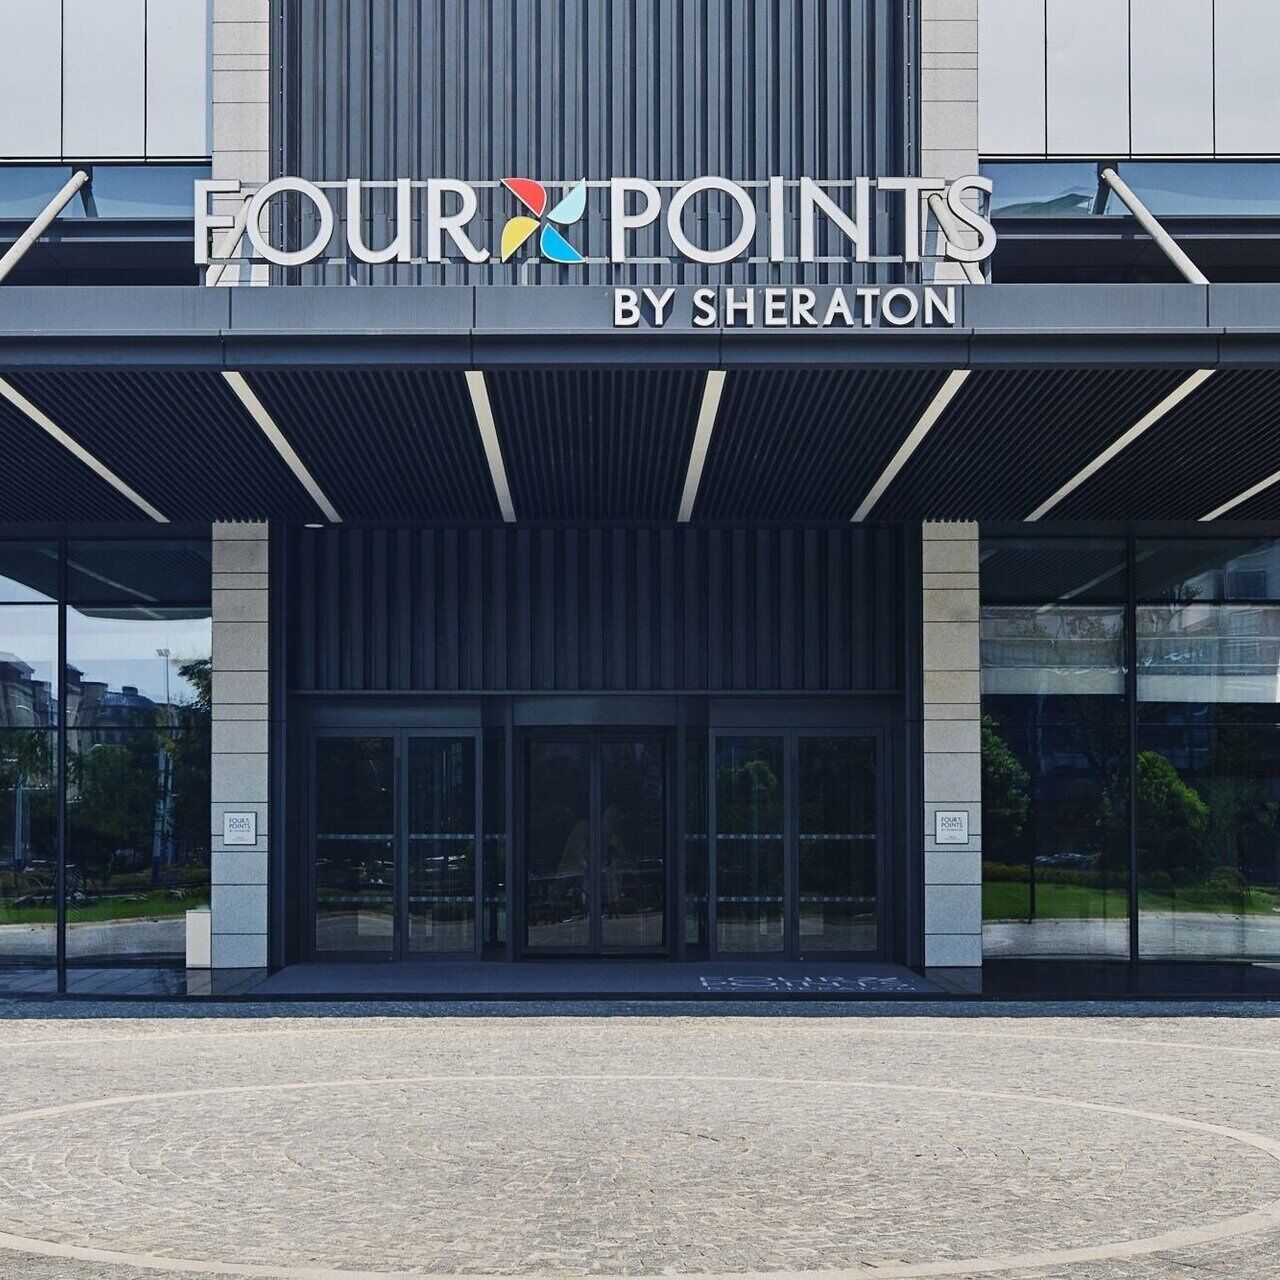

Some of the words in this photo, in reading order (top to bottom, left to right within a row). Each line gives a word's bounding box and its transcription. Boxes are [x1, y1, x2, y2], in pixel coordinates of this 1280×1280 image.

[194, 176, 490, 265] FOUR
[611, 175, 997, 264] POINTS
[614, 288, 675, 326] BY
[693, 287, 956, 326] SHERATON
